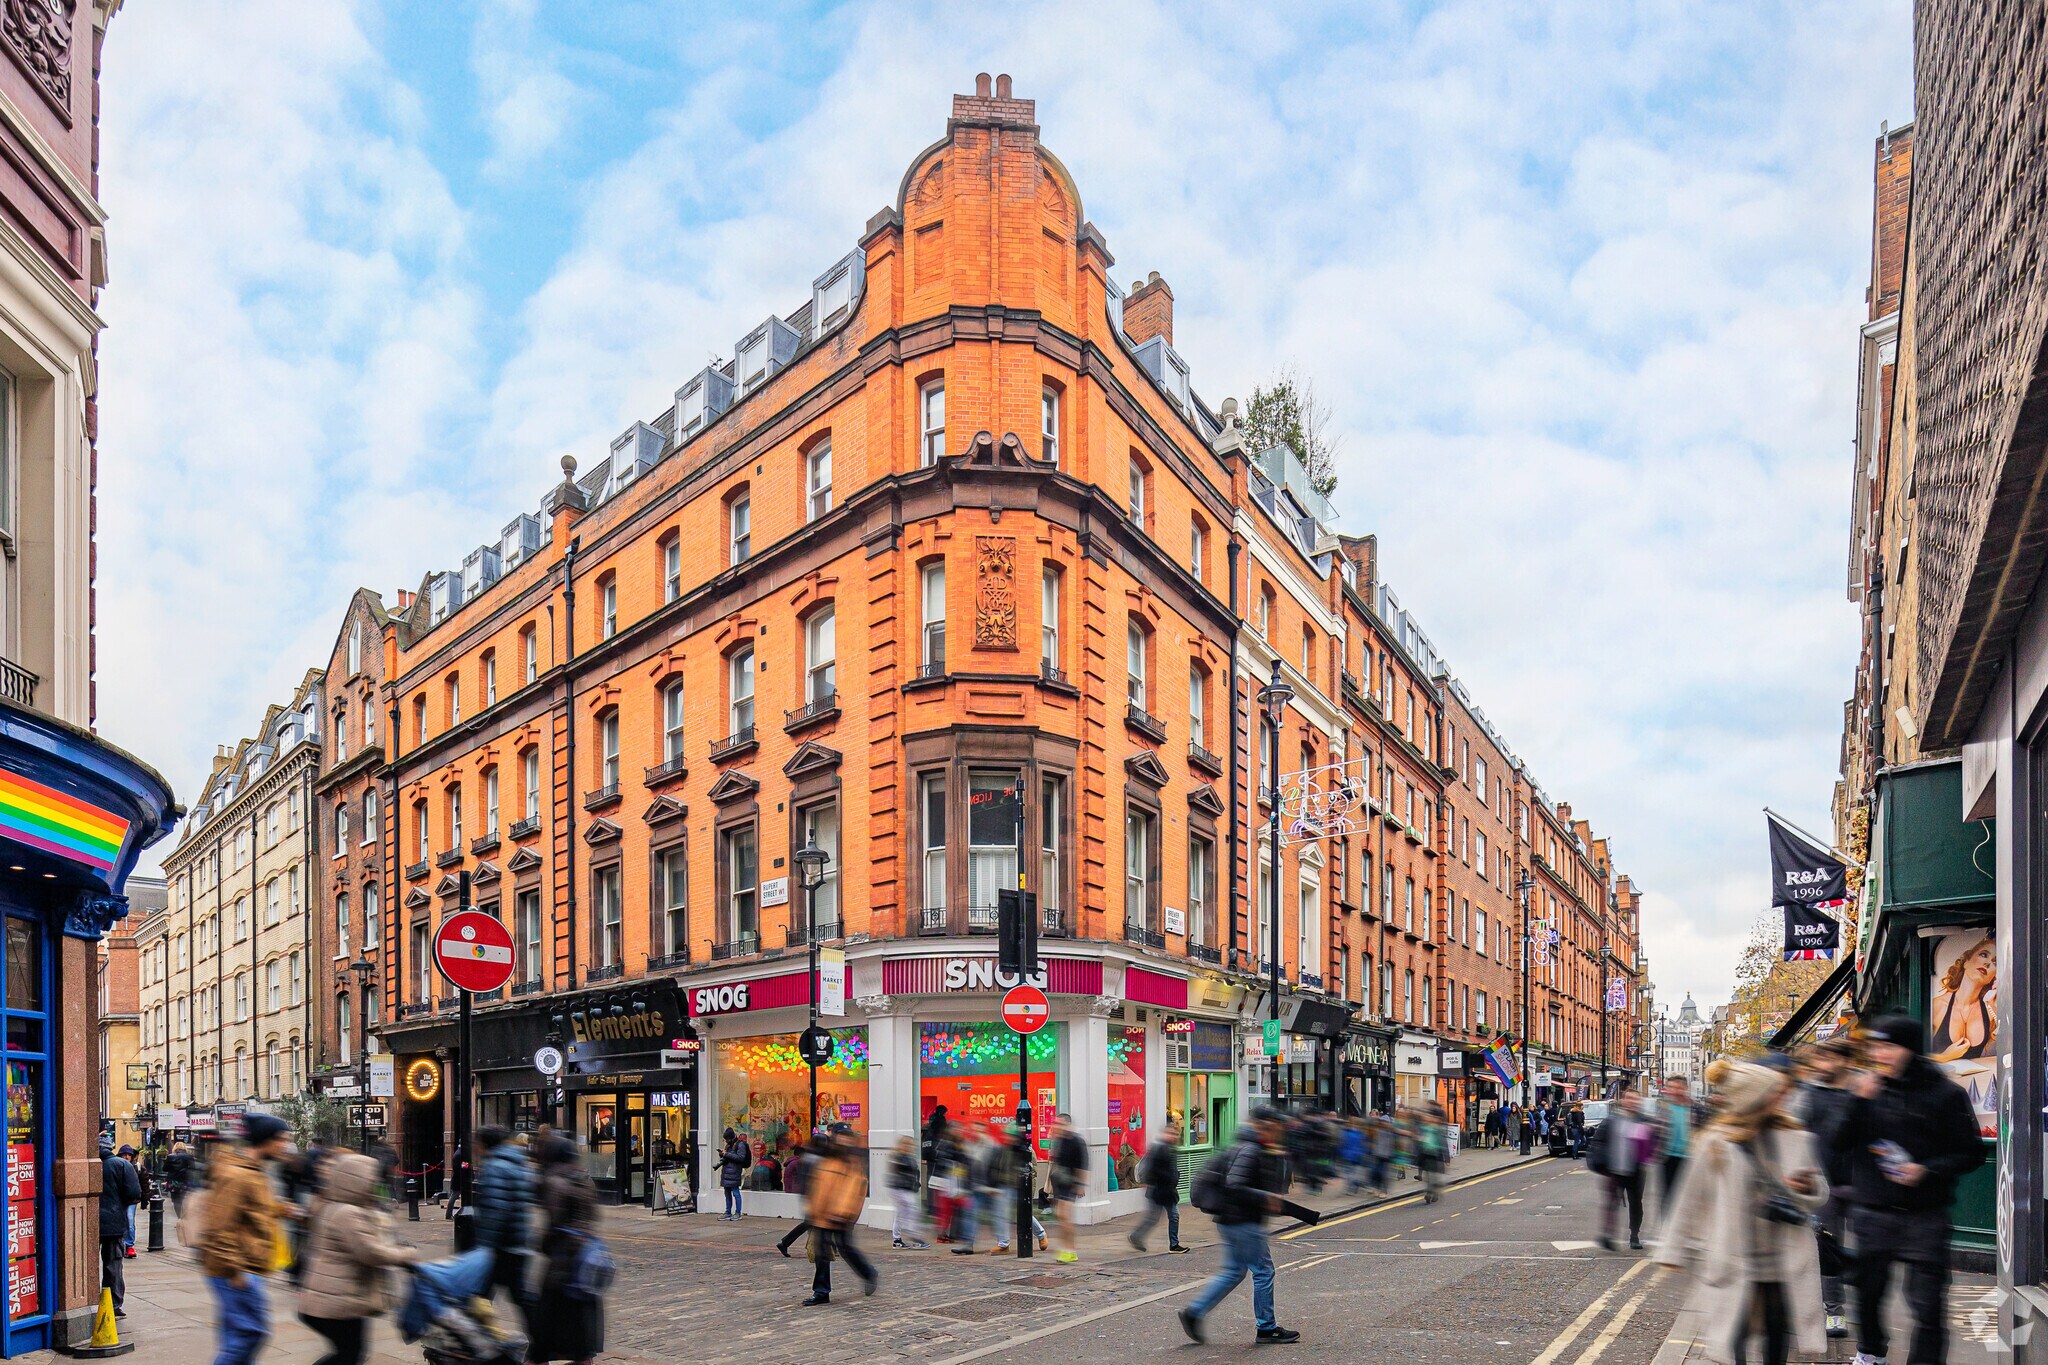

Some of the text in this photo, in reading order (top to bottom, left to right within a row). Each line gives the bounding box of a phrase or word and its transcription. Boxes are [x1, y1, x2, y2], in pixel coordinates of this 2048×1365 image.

[1785, 867, 1831, 886] R&A
[763, 882, 778, 891] RUPERT
[763, 890, 778, 899] STREET
[1793, 886, 1824, 899] 1996
[1794, 923, 1829, 936] R&A
[1800, 937, 1823, 947] 1996
[946, 960, 1048, 989] SNOG
[822, 976, 843, 984] MARKET
[696, 984, 748, 1014] SNOG
[571, 1010, 664, 1043] Elements
[1166, 1022, 1191, 1032] SNOG
[677, 1041, 700, 1050] SNOG
[1293, 1043, 1312, 1052] HAI
[1246, 1048, 1262, 1056] Relax
[1501, 1048, 1517, 1073] SPLASH
[970, 1093, 1005, 1108] SNOG
[191, 1118, 215, 1126] MASSAGE
[990, 1116, 1015, 1124] SNOG
[7, 1148, 20, 1197] SALE!
[19, 1171, 35, 1179] ON!
[19, 1220, 34, 1228] NOW
[7, 1205, 19, 1254] SALE!
[19, 1226, 34, 1236] ON!
[20, 1277, 35, 1287] NOW
[8, 1265, 21, 1314] SALE!
[20, 1284, 36, 1295] ON!
